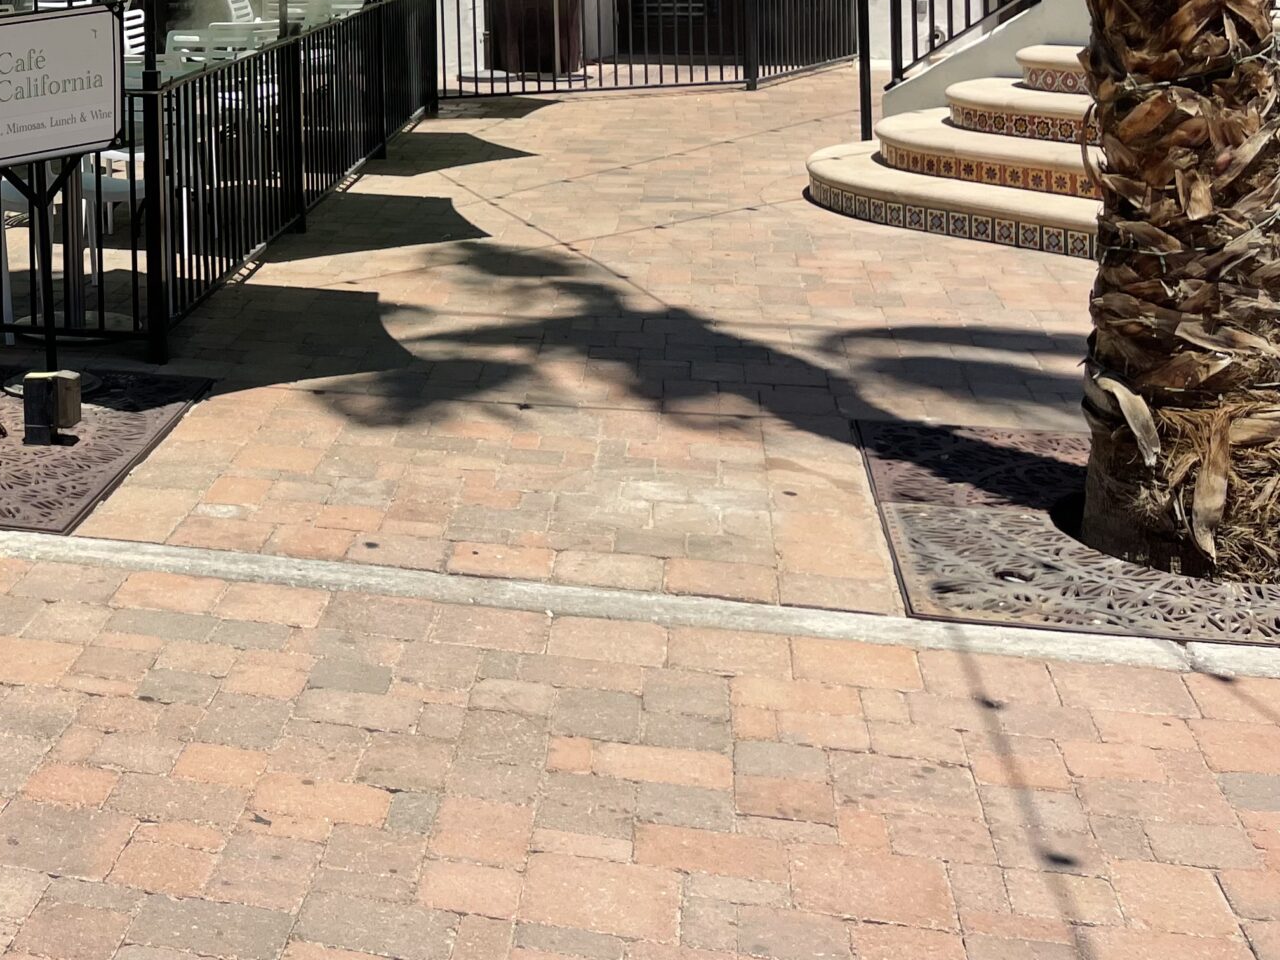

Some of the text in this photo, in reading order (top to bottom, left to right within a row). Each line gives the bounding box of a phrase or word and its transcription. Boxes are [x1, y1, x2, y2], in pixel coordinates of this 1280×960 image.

[49, 113, 77, 128] Lunch
[79, 111, 87, 123] &
[90, 109, 113, 120] Wine
